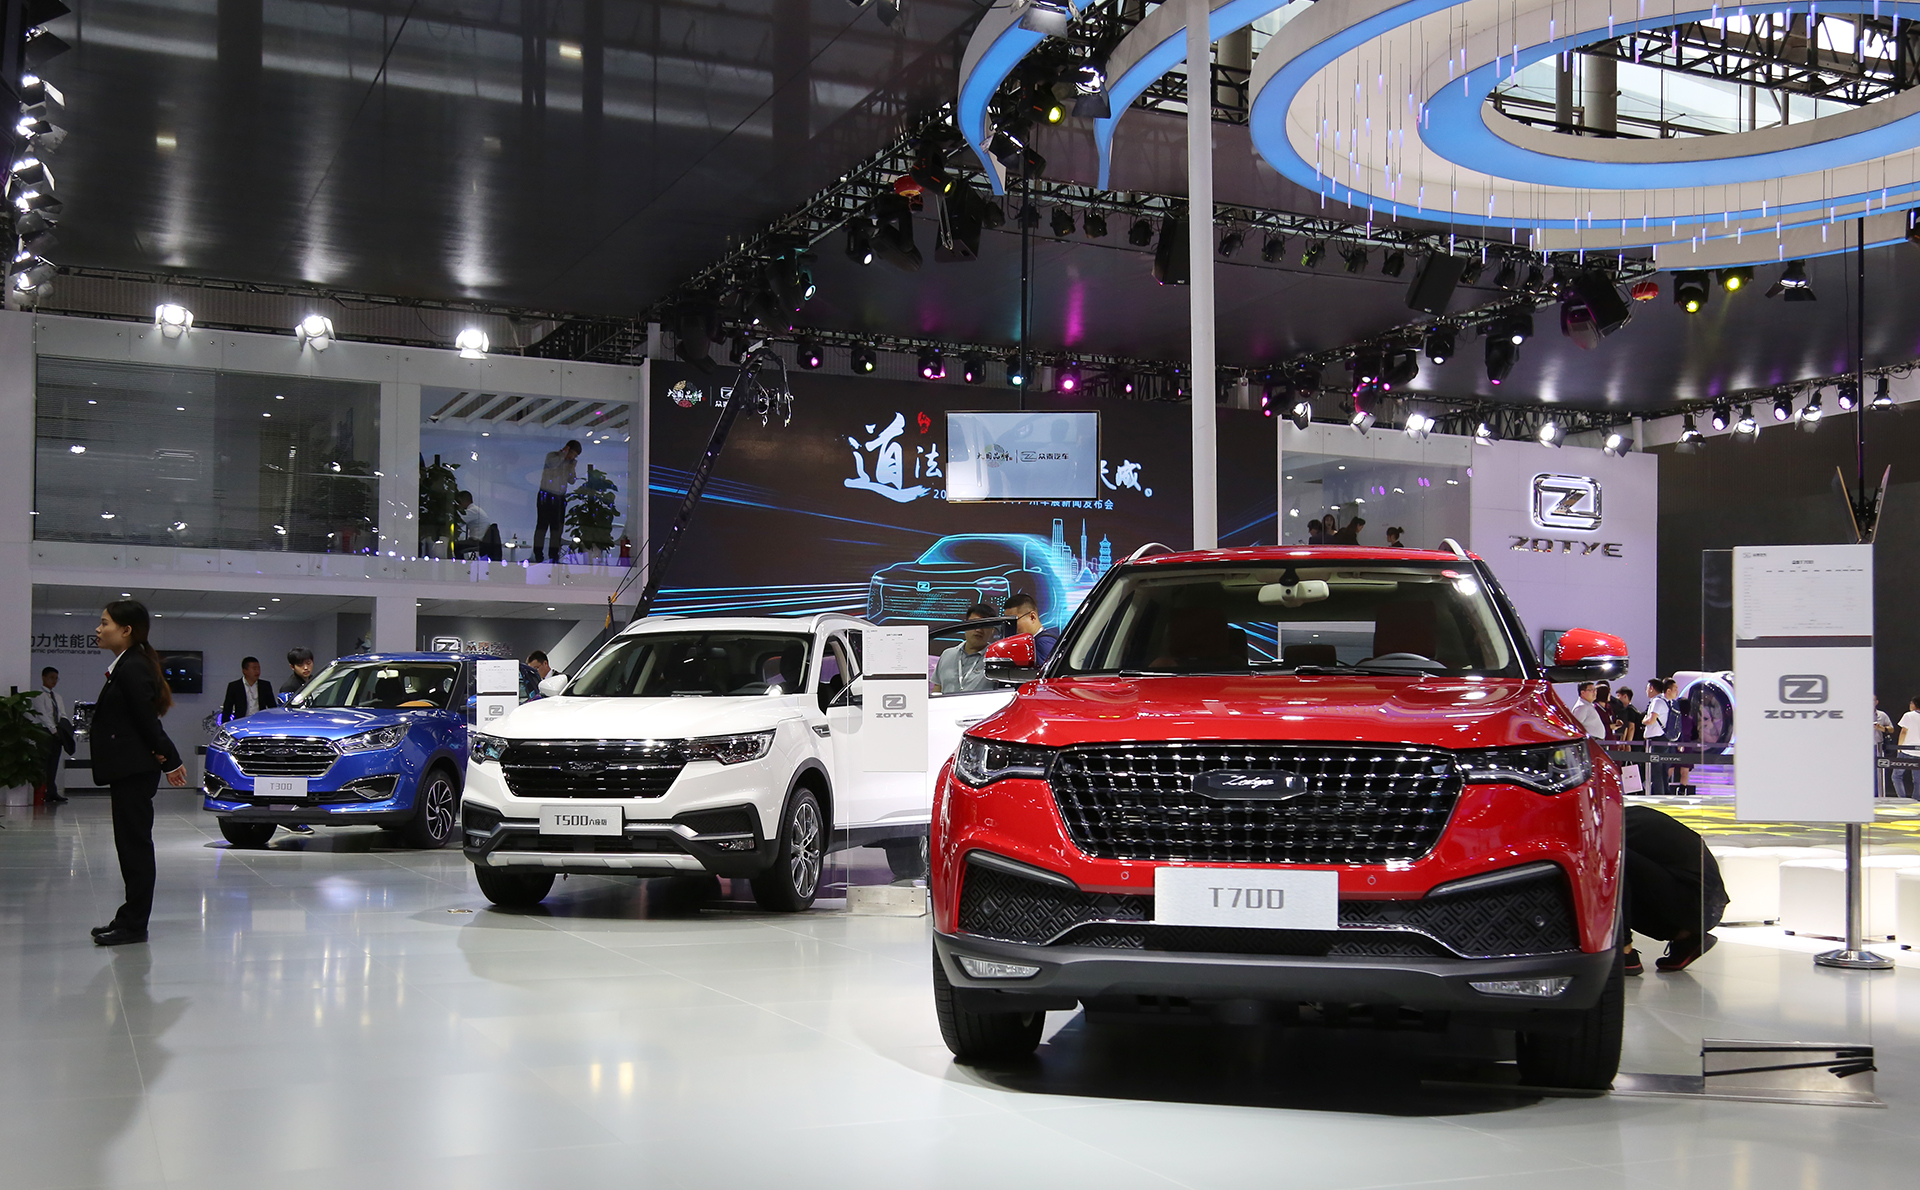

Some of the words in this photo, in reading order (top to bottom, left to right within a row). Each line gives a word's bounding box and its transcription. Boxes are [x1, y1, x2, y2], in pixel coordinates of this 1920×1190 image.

[1508, 535, 1623, 558] ZOTYE
[31, 633, 100, 648] 力性能区
[1764, 710, 1843, 719] ZOTYE
[270, 782, 293, 791] T300
[1208, 887, 1285, 910] T700
